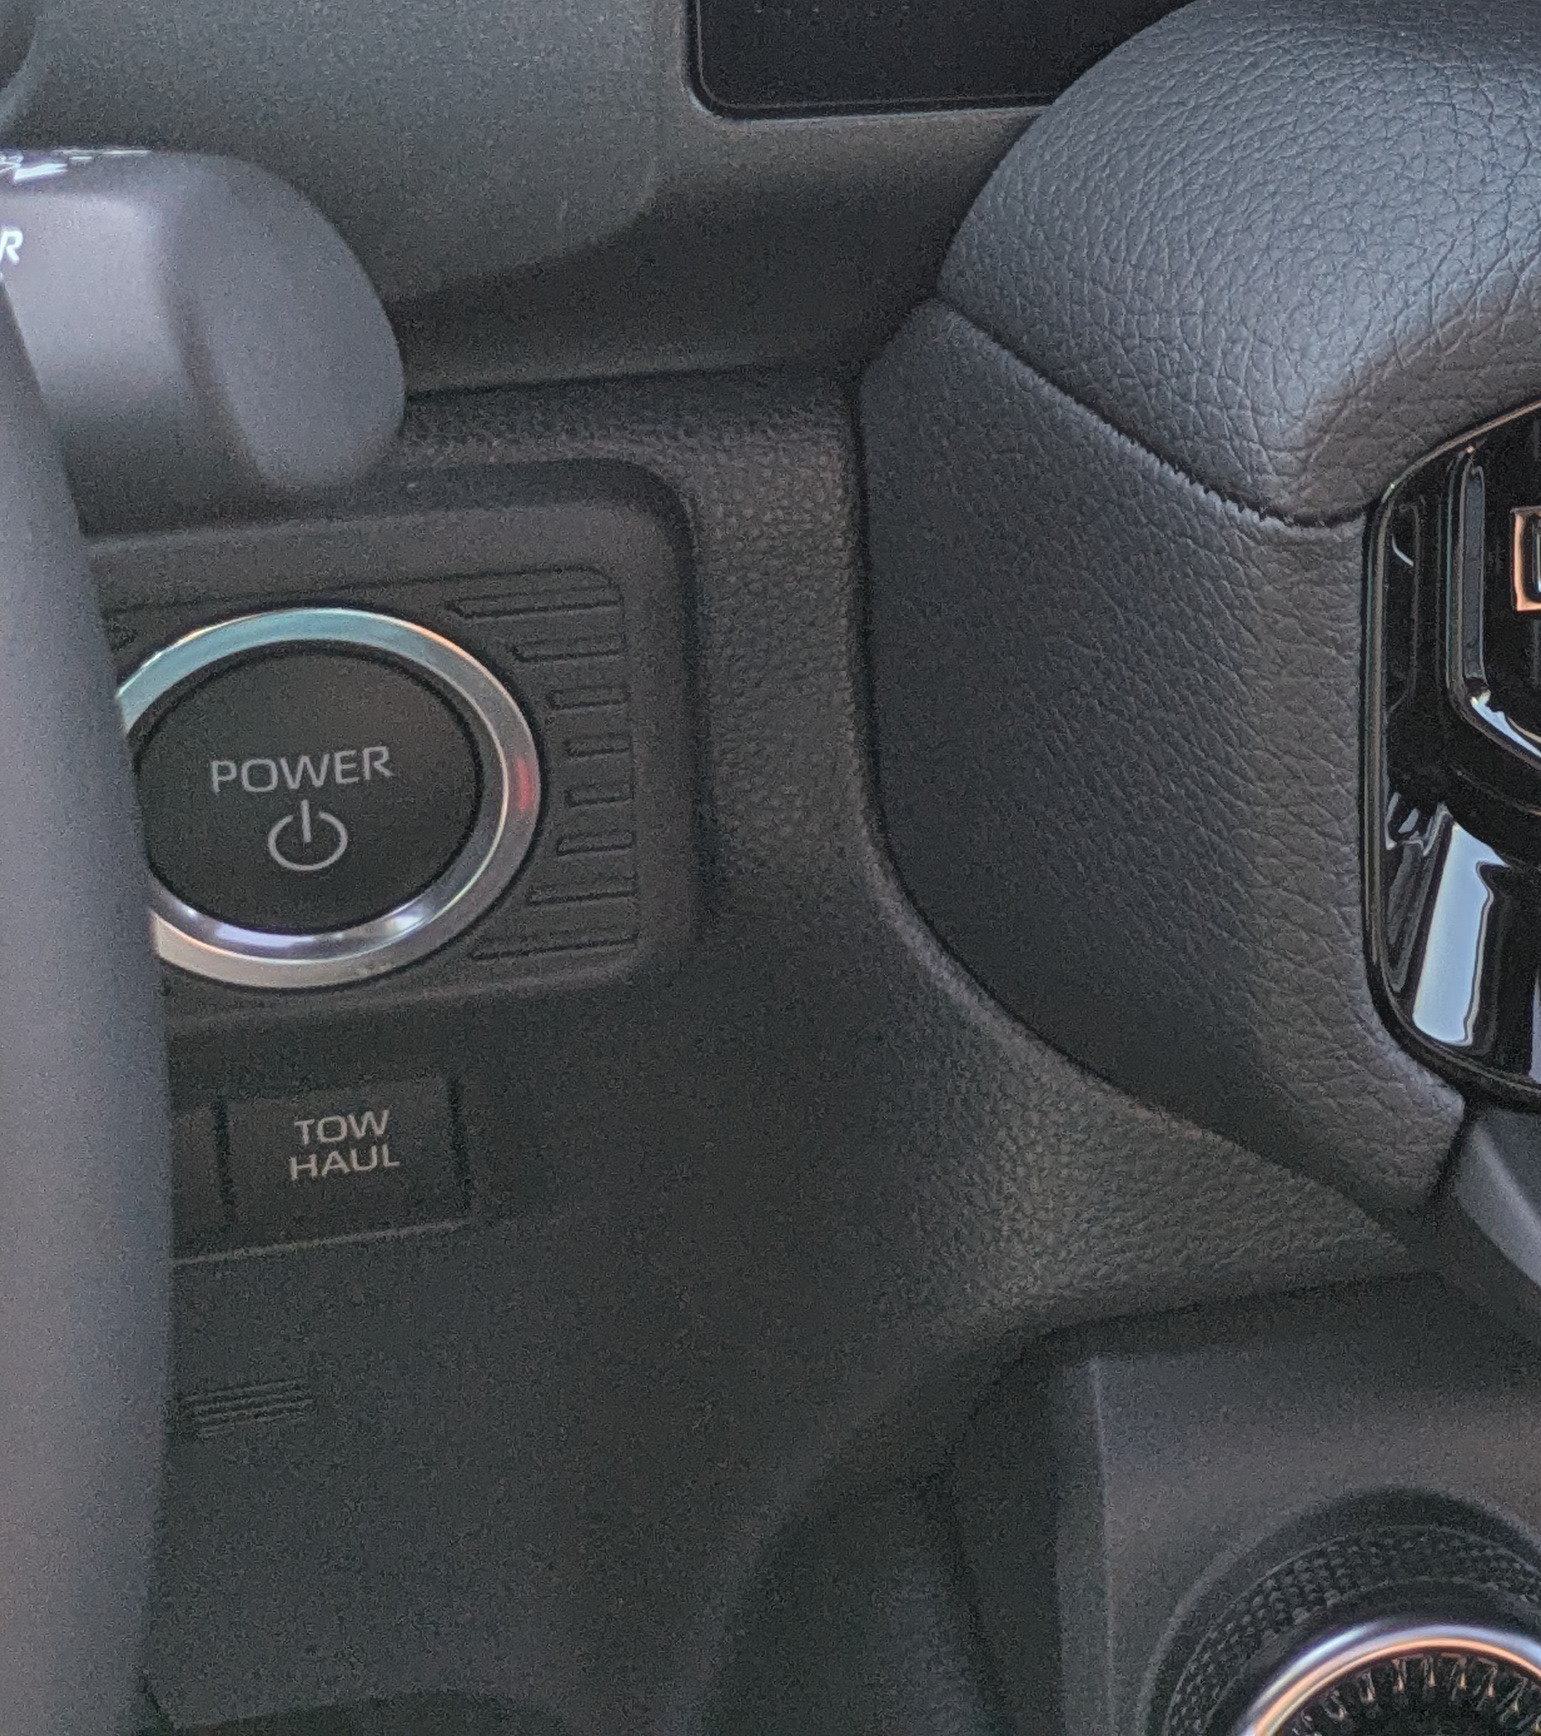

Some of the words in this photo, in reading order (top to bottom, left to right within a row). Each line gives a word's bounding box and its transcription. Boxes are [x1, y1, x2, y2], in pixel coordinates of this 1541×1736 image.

[211, 745, 394, 794] POWER
[294, 1109, 391, 1145] TOW
[289, 1140, 400, 1182] HAUL
